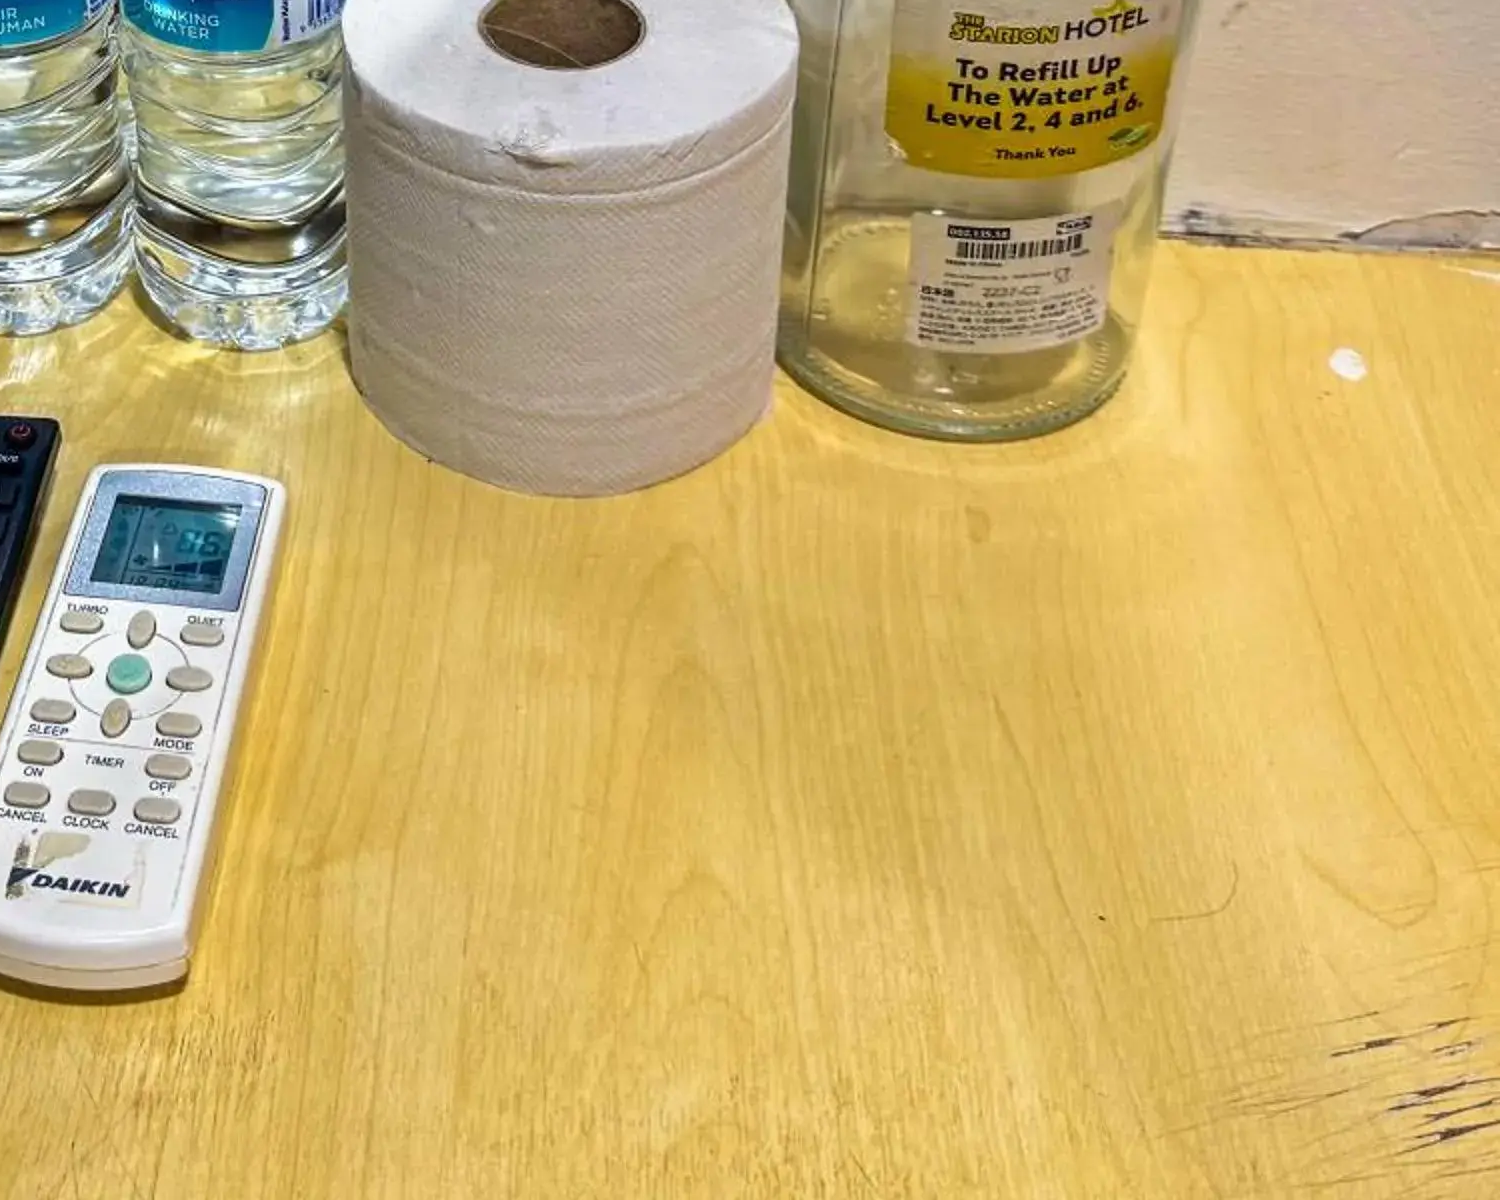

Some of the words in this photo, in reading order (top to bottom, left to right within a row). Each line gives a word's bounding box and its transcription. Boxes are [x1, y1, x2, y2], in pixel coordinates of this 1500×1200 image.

[143, 0, 220, 27] DRINKING
[152, 16, 210, 39] WATER
[949, 22, 1060, 44] STARION
[1064, 7, 1150, 40] HOTEL
[956, 58, 989, 80] To
[999, 58, 1079, 82] Refill
[1087, 54, 1122, 78] Up
[948, 82, 1000, 106] The
[1009, 85, 1097, 106] Water
[1103, 75, 1129, 96] at
[926, 103, 1002, 131] Level
[1011, 112, 1035, 132] 2,
[1044, 111, 1061, 128] 4
[1069, 98, 1119, 126] and
[995, 148, 1045, 160] Thank
[1049, 145, 1076, 158] You
[187, 615, 225, 626] QUIET
[27, 724, 70, 737] SLEEP
[153, 738, 194, 751] MODE
[84, 753, 125, 769] TIMER
[23, 766, 44, 778] ON
[148, 781, 177, 793] OFF
[62, 815, 110, 831] CLOCK
[124, 822, 180, 839] CANCEL
[31, 872, 130, 899] DAIKIN
